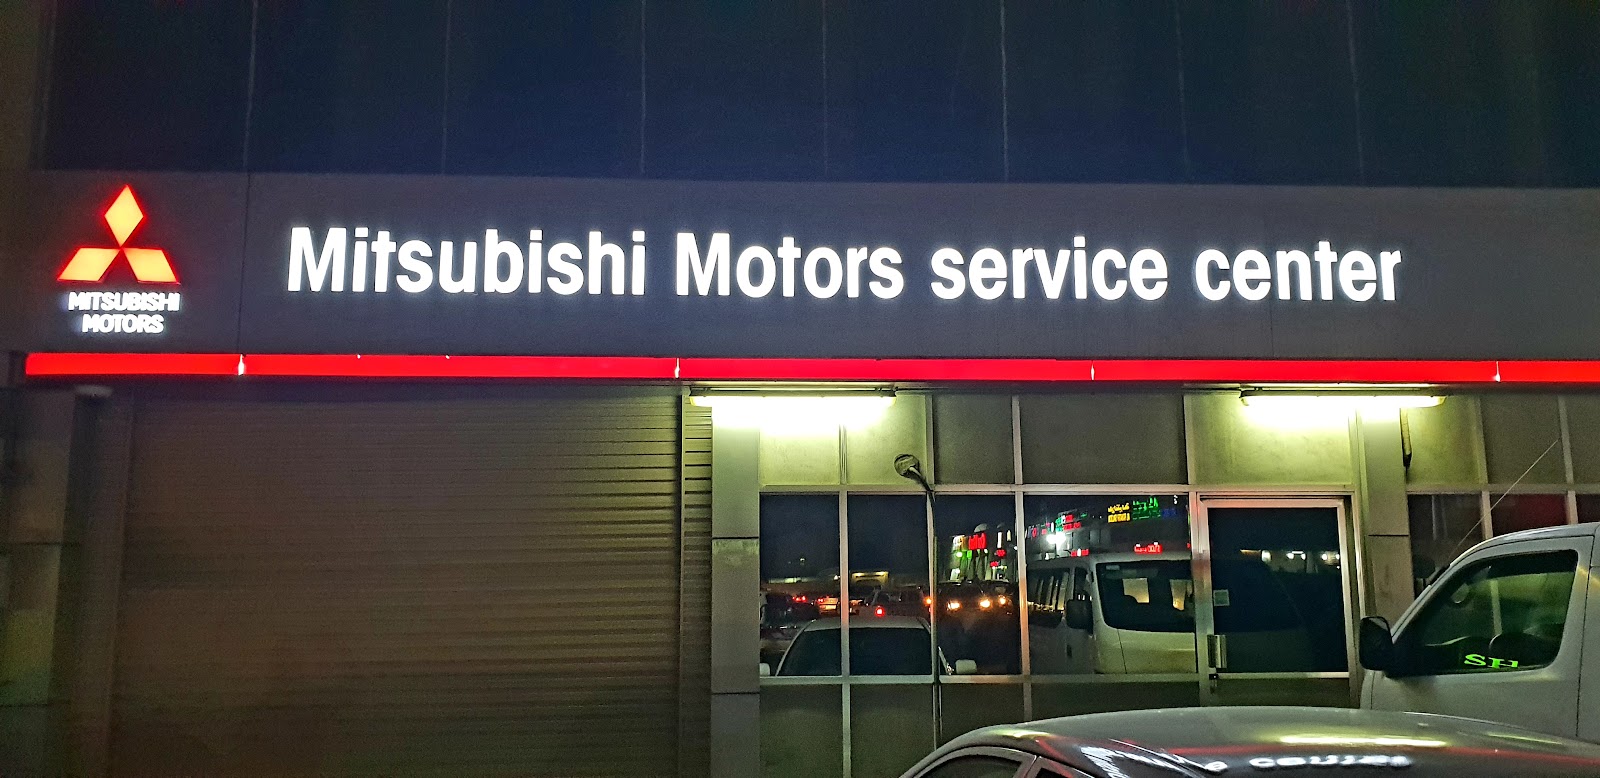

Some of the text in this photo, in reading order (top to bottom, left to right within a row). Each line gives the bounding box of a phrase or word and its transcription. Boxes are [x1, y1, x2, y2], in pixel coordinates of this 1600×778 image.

[288, 227, 1402, 302] Mitsubishi Motors service center
[68, 291, 181, 315] MITSUBISHI
[82, 313, 165, 334] MOTORS
